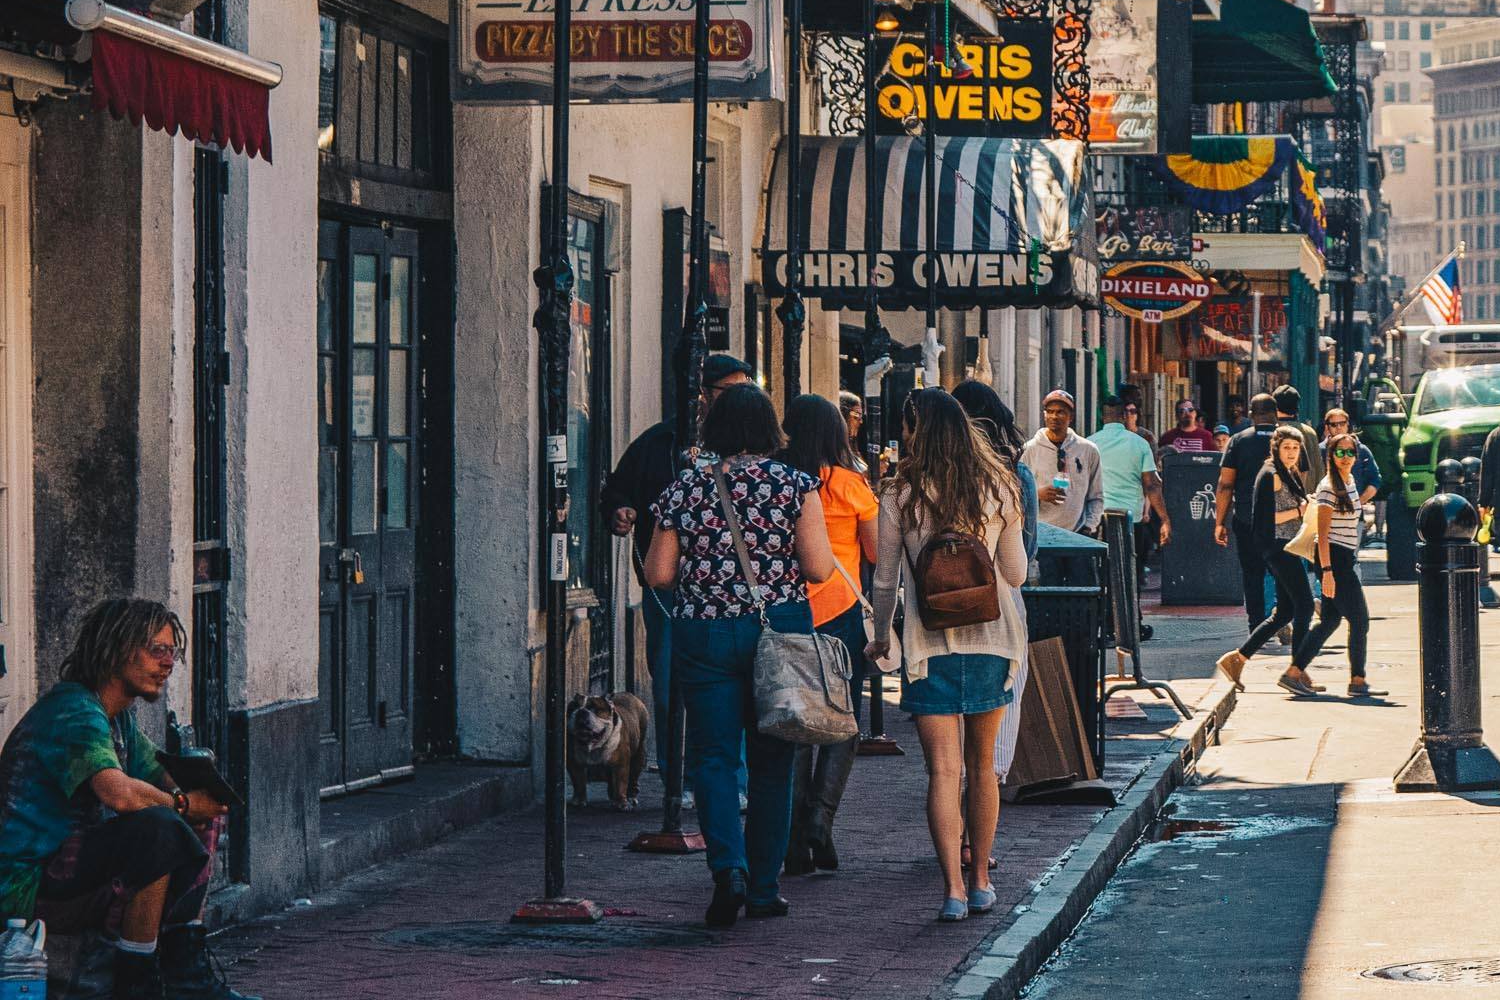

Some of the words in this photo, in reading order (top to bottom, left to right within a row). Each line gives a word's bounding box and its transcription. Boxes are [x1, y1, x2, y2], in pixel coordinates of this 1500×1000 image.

[612, 24, 661, 57] THE
[669, 24, 742, 57] SLCE
[878, 85, 1042, 121] OWENS
[775, 253, 895, 288] CHRIS
[912, 253, 1053, 288] OWENS
[1101, 279, 1209, 297] DIXIELAND
[1143, 311, 1161, 320] ATM
